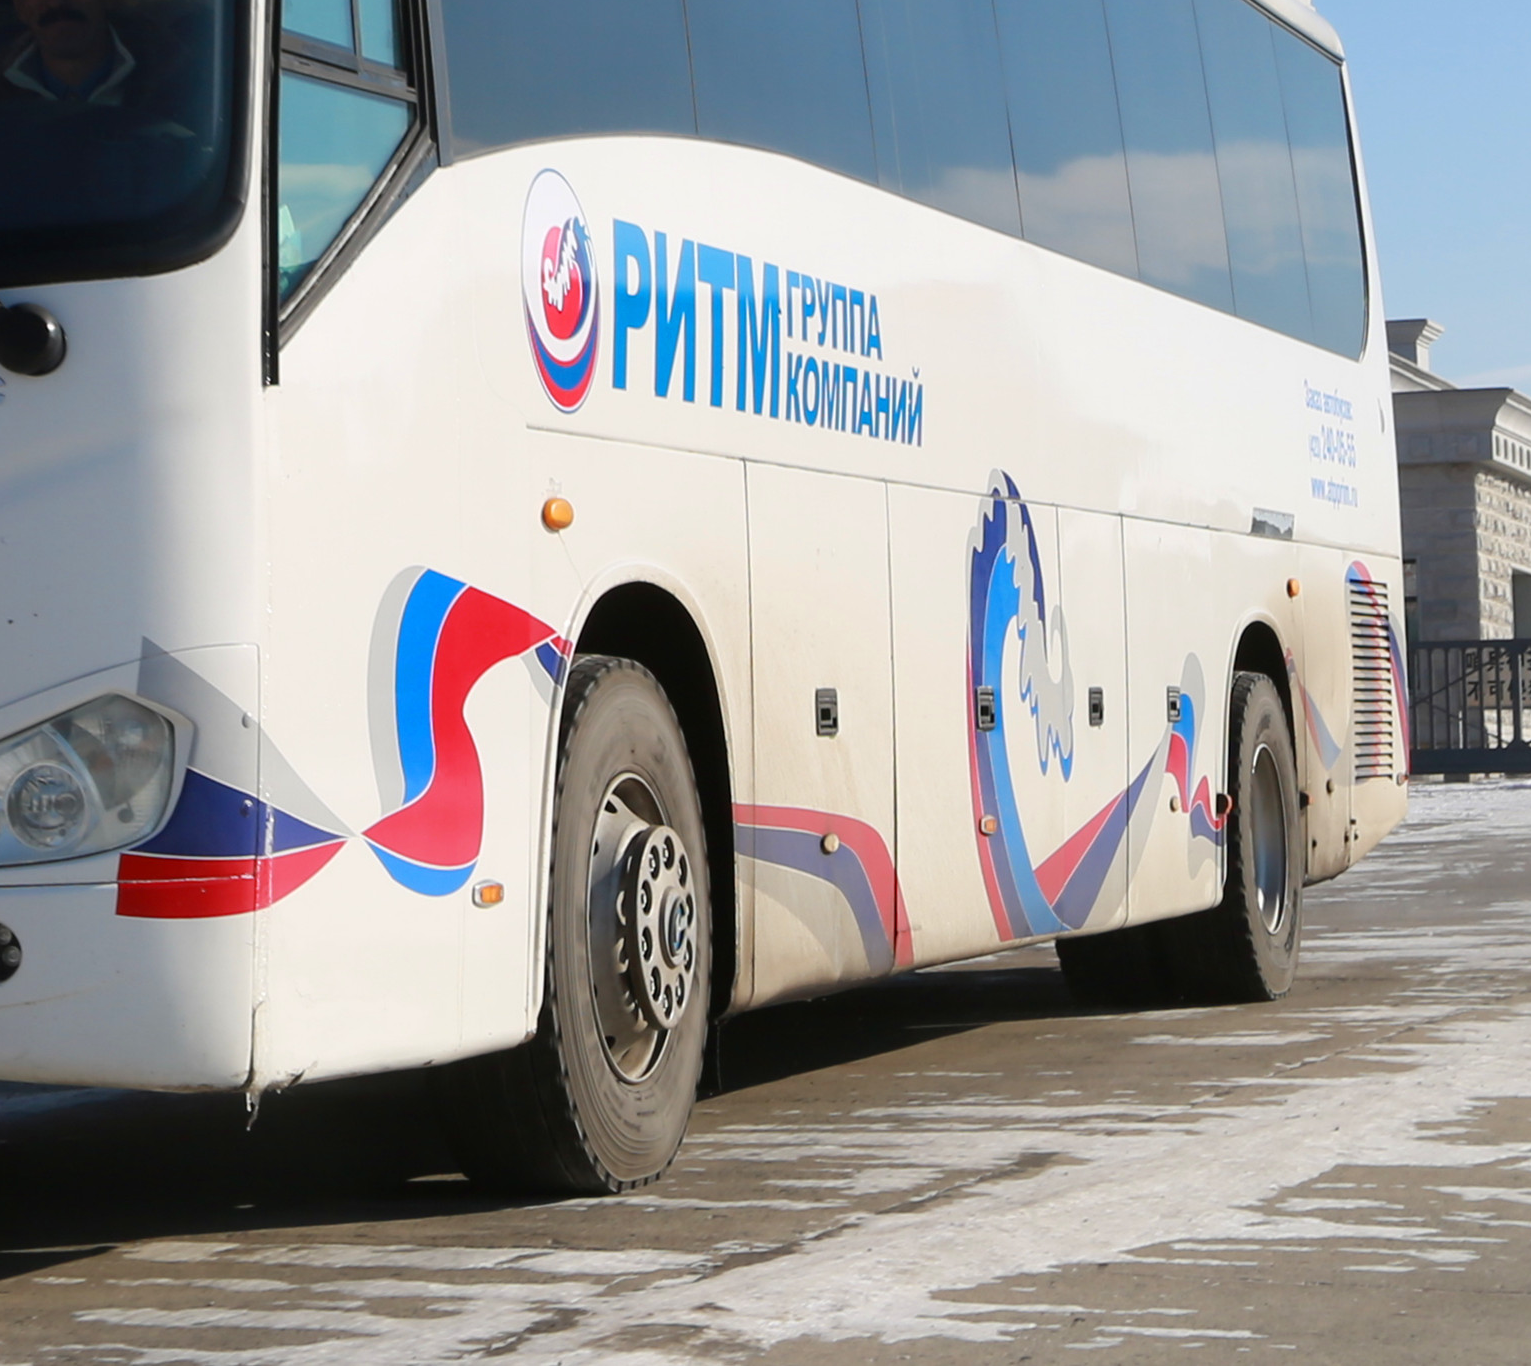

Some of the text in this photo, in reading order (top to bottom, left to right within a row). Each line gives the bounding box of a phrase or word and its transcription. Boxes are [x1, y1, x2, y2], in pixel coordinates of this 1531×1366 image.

[612, 218, 883, 419] РИТМ ГРУППА
[785, 352, 924, 447] КОМПАНИЙ
